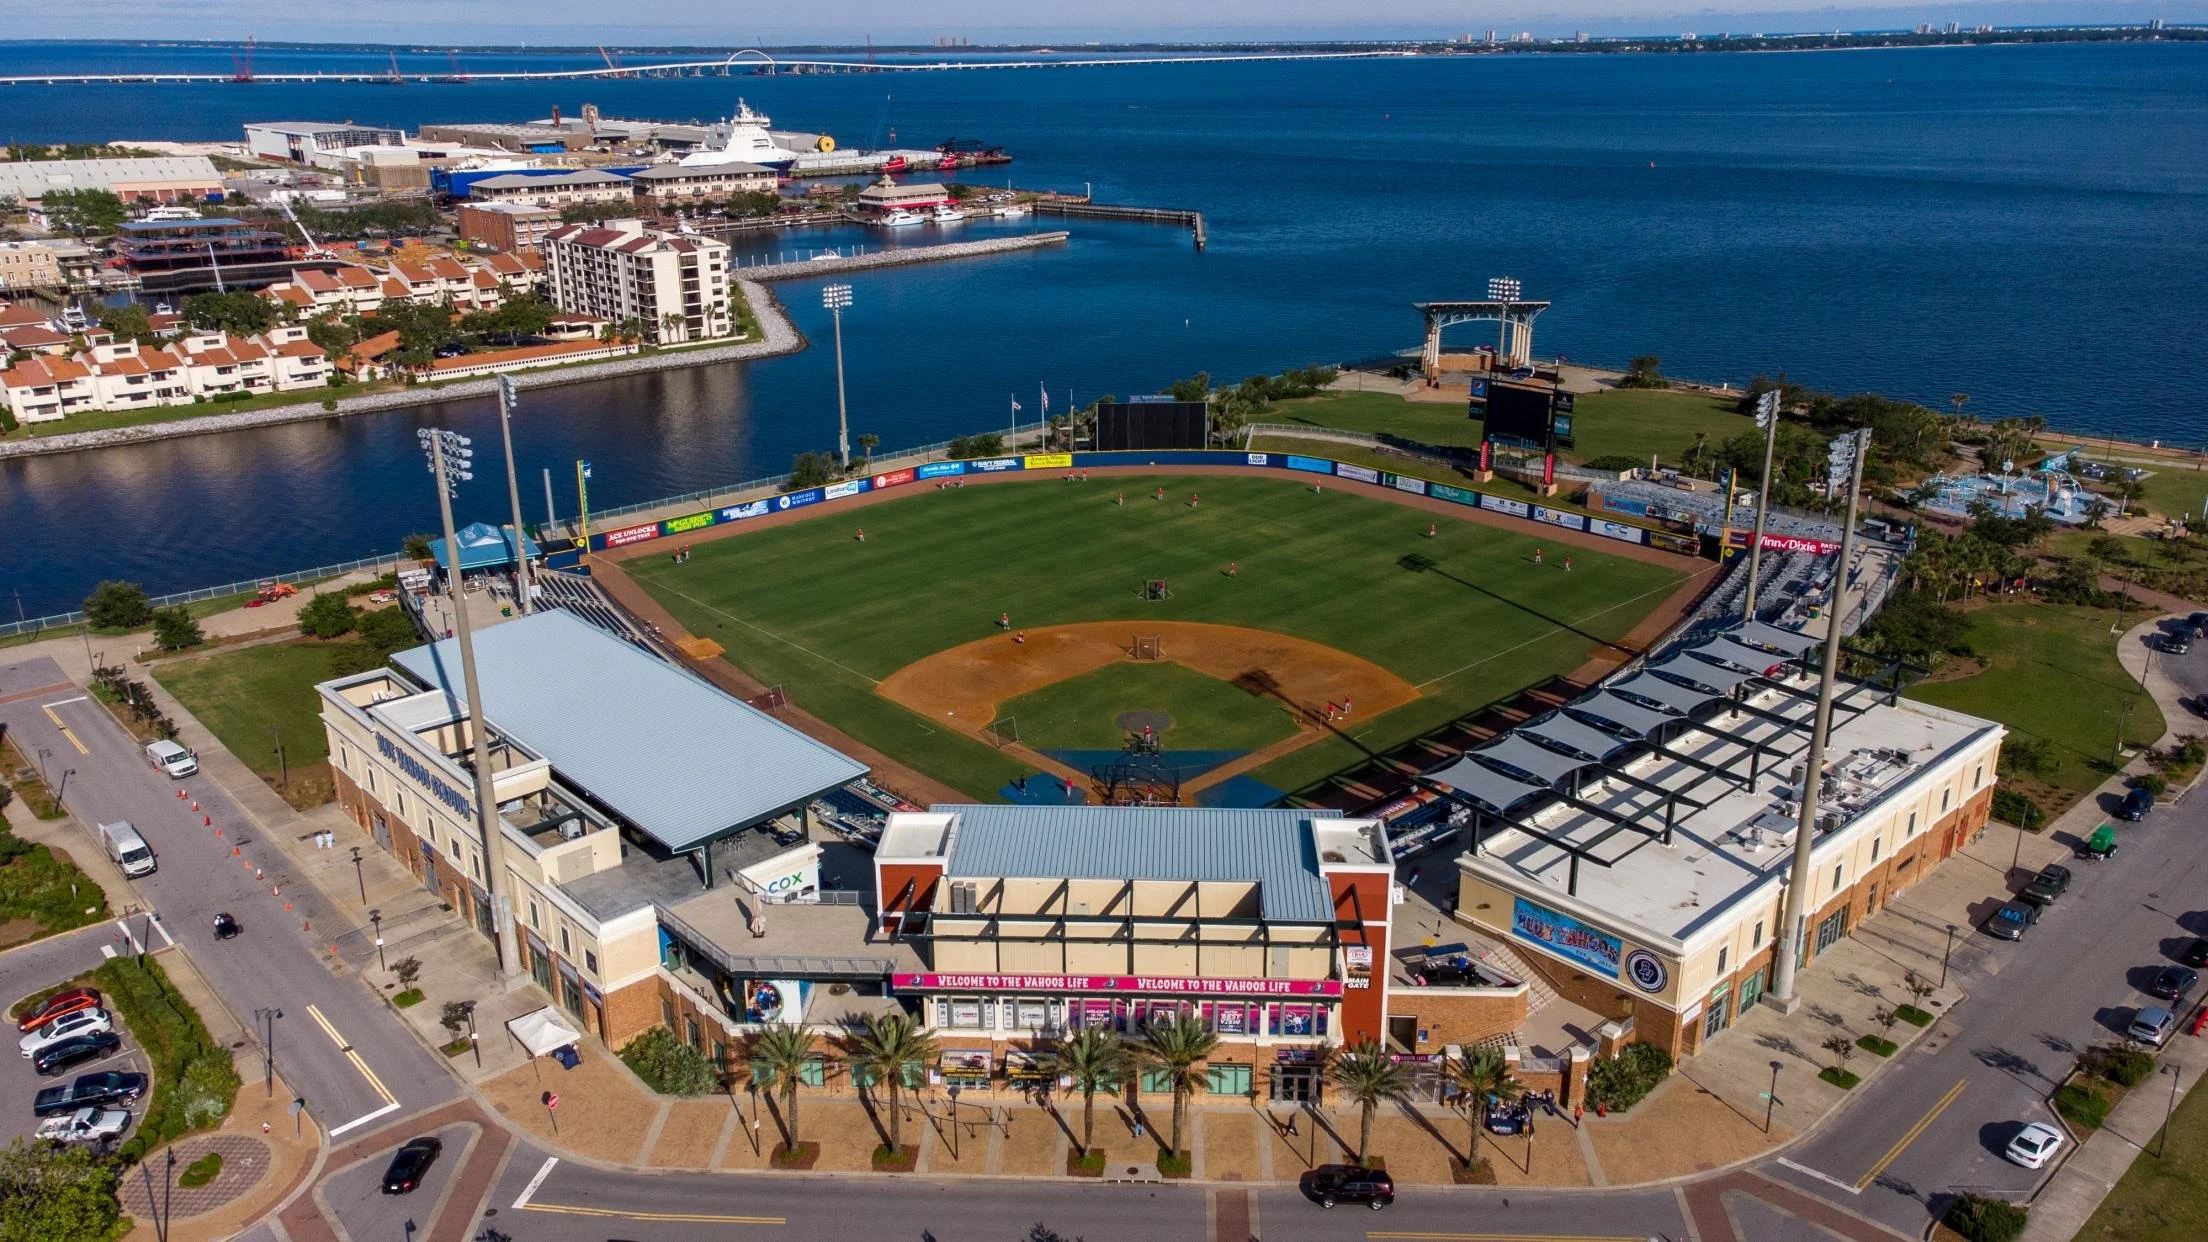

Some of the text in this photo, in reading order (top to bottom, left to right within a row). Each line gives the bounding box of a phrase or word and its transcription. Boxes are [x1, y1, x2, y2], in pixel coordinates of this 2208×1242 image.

[608, 525, 656, 541] ACE UNLOCKS
[1788, 539, 1816, 552] Dixie
[768, 872, 802, 895] COX
[938, 975, 1089, 988] WELCOME TO THE WAHOOS LIFE
[1137, 978, 1291, 992] WELCOME TO THE WAHOOS LIFE
